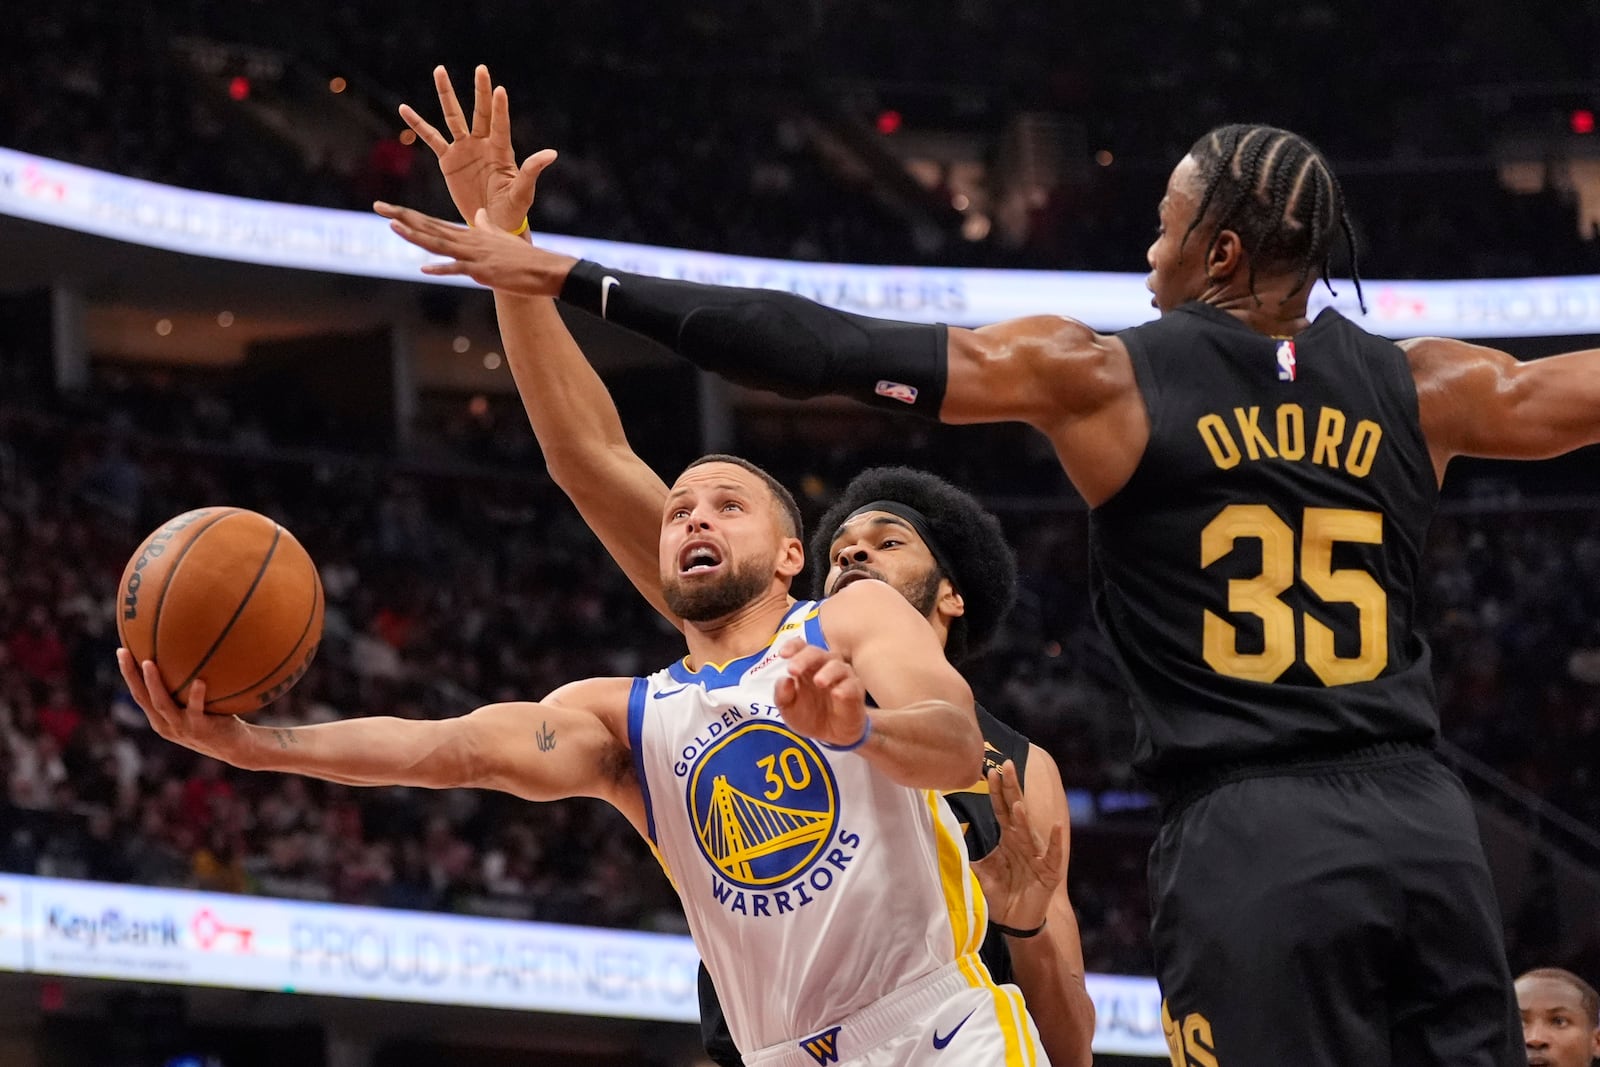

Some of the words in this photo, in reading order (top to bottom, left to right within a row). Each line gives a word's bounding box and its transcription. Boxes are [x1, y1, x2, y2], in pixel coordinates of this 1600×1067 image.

[1197, 403, 1382, 478] OKORO
[1201, 504, 1388, 687] 35
[674, 706, 743, 777] GOLDEN
[756, 747, 811, 801] 30
[711, 830, 860, 917] WARRIORS
[47, 907, 179, 949] KeyBank
